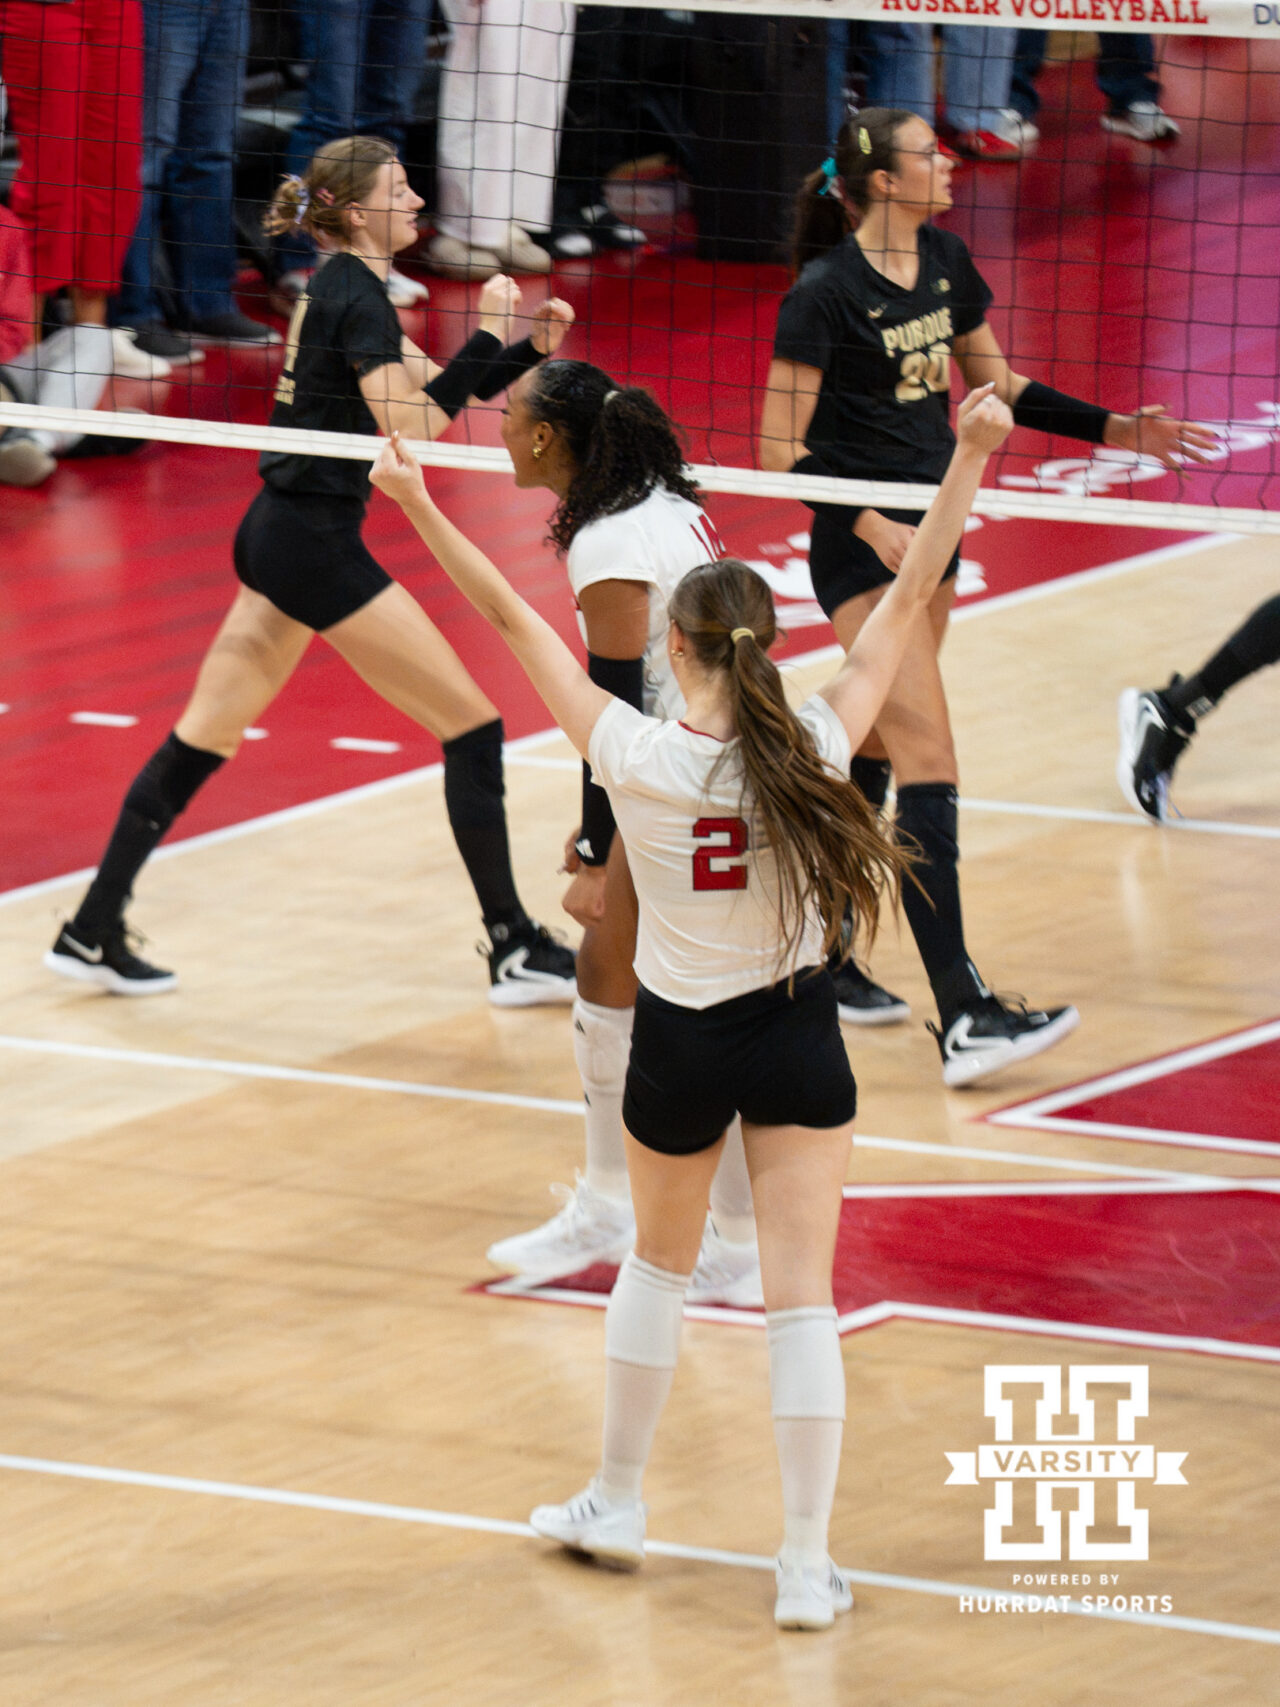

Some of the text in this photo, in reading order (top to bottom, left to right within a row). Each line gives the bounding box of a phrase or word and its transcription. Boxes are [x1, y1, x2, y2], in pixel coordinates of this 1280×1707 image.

[1010, 0, 1209, 25] VOLLEYBALL
[894, 341, 951, 403] 20
[692, 817, 749, 892] 2
